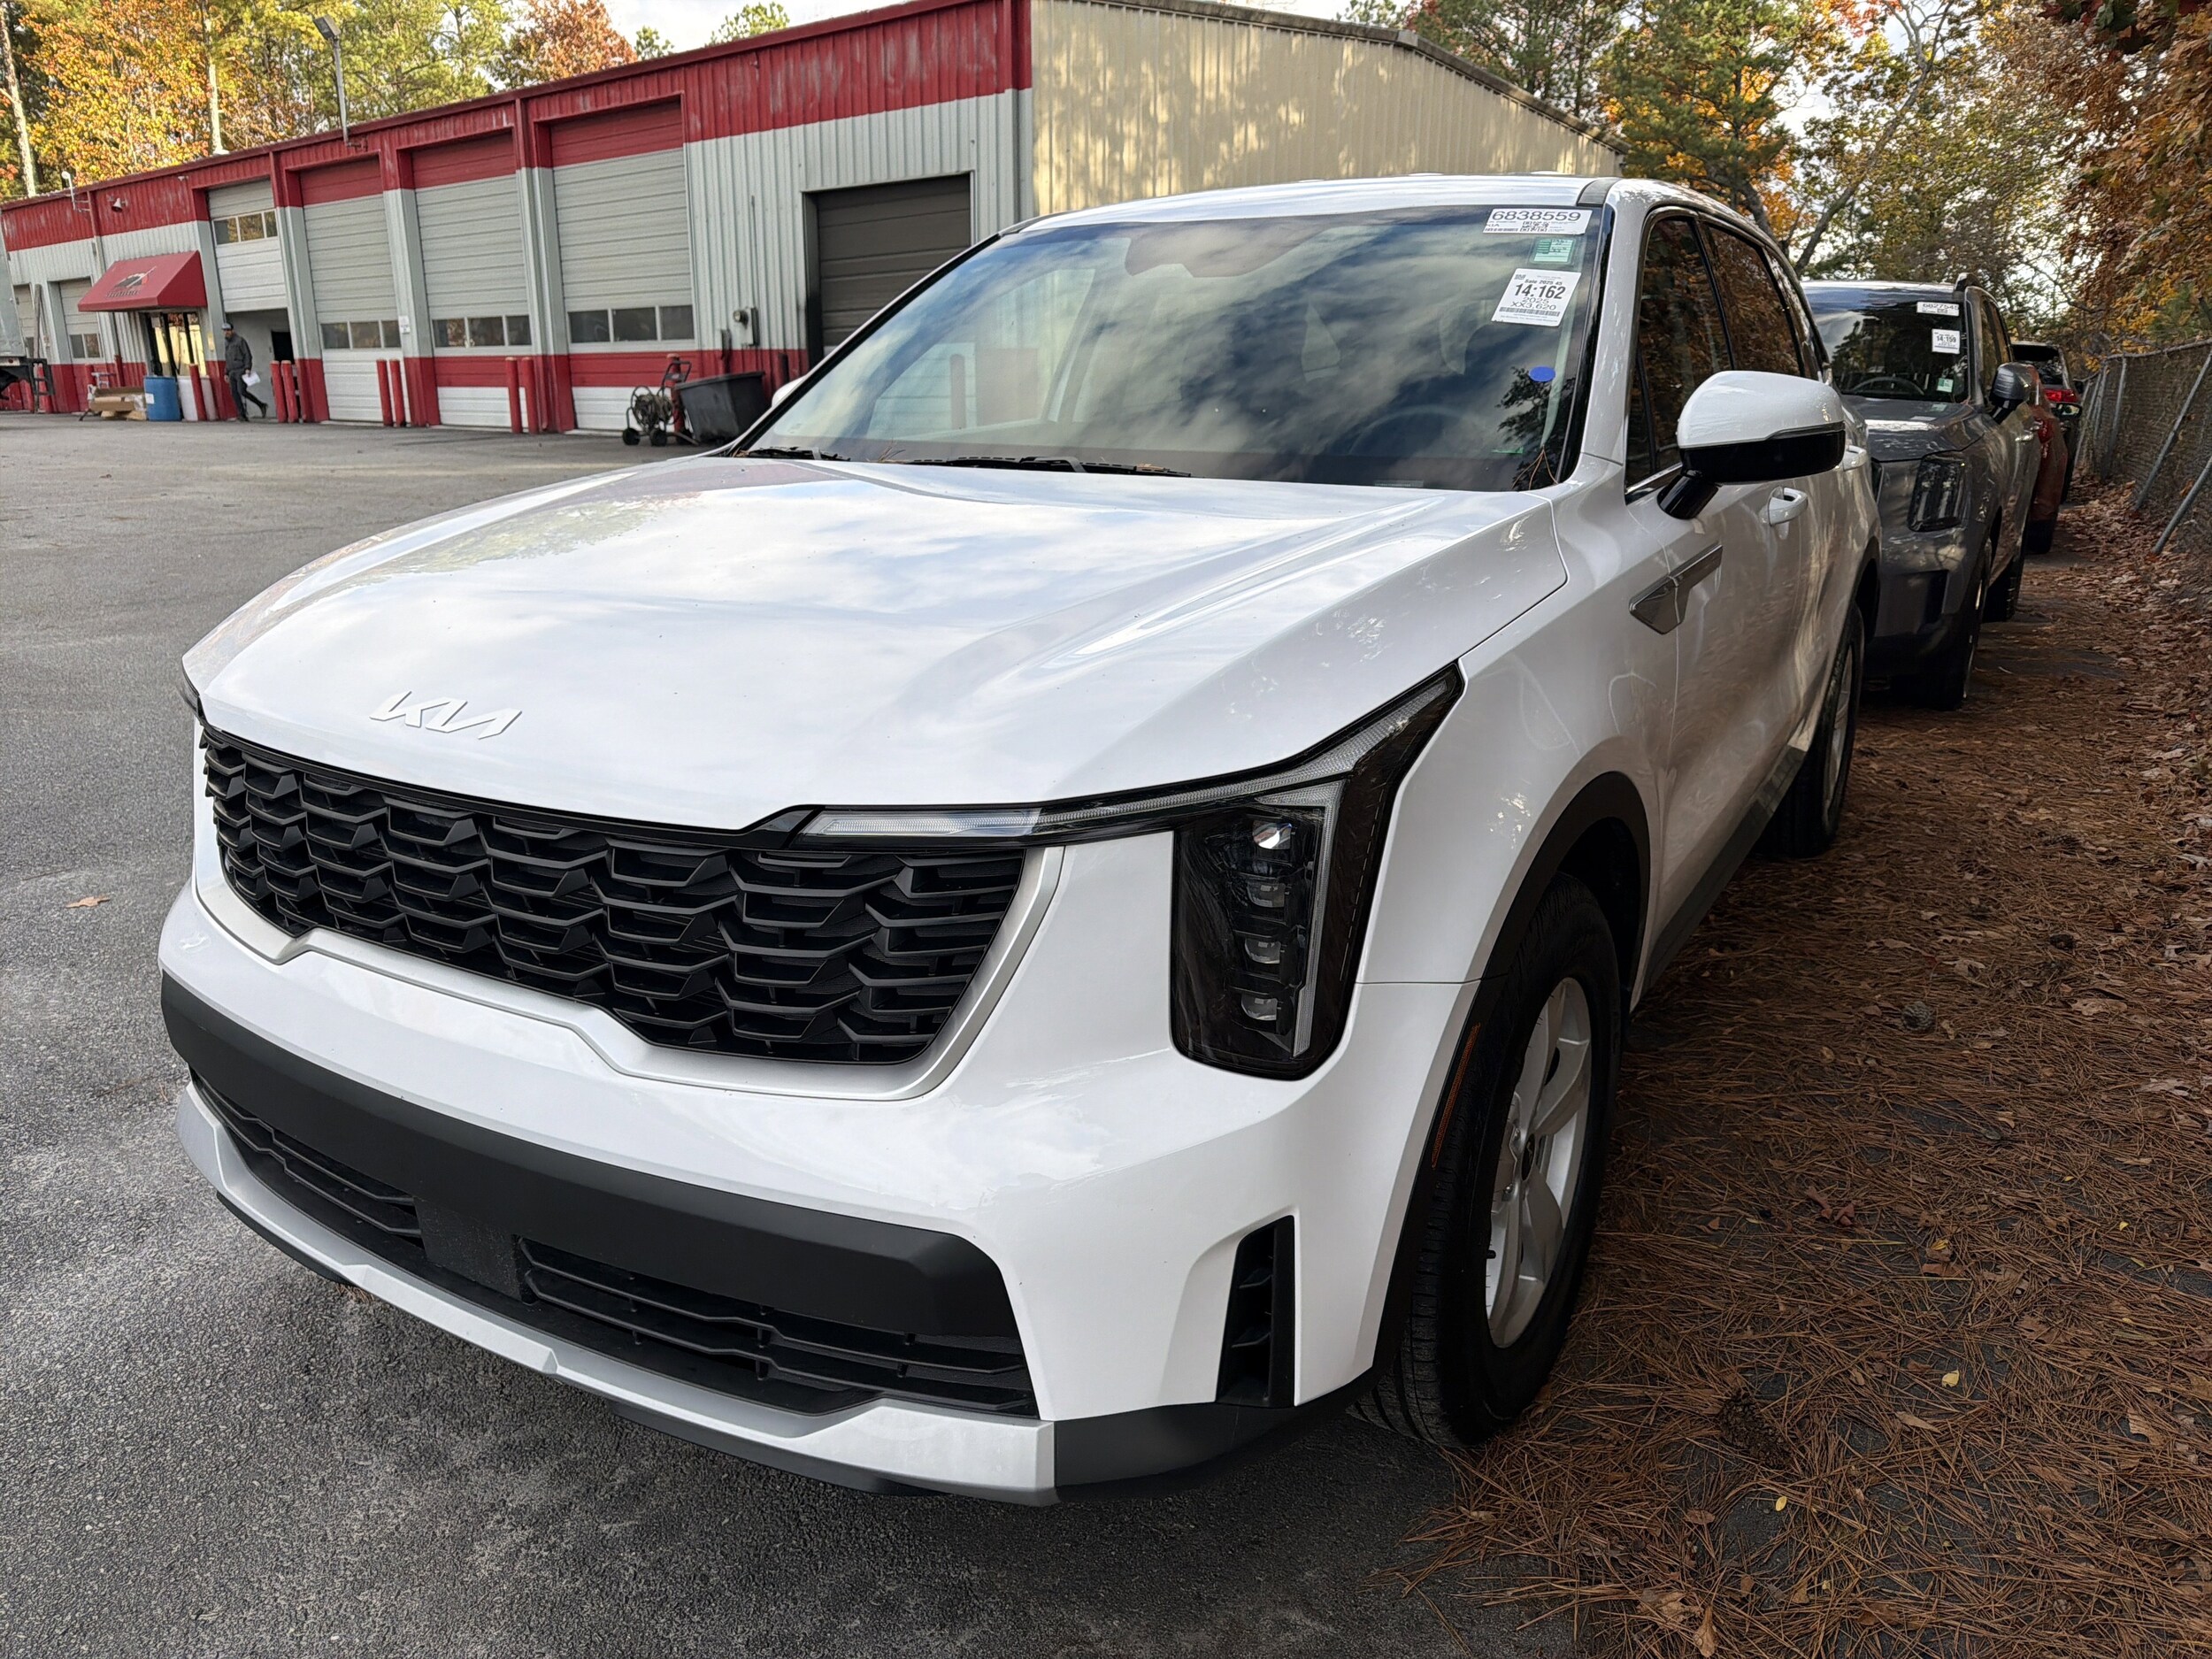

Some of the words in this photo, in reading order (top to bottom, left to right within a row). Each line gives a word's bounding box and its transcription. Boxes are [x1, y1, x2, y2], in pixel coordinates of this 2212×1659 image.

[1492, 211, 1581, 221] 6838559
[1514, 283, 1566, 299] 14:162
[369, 690, 523, 740] KIA
